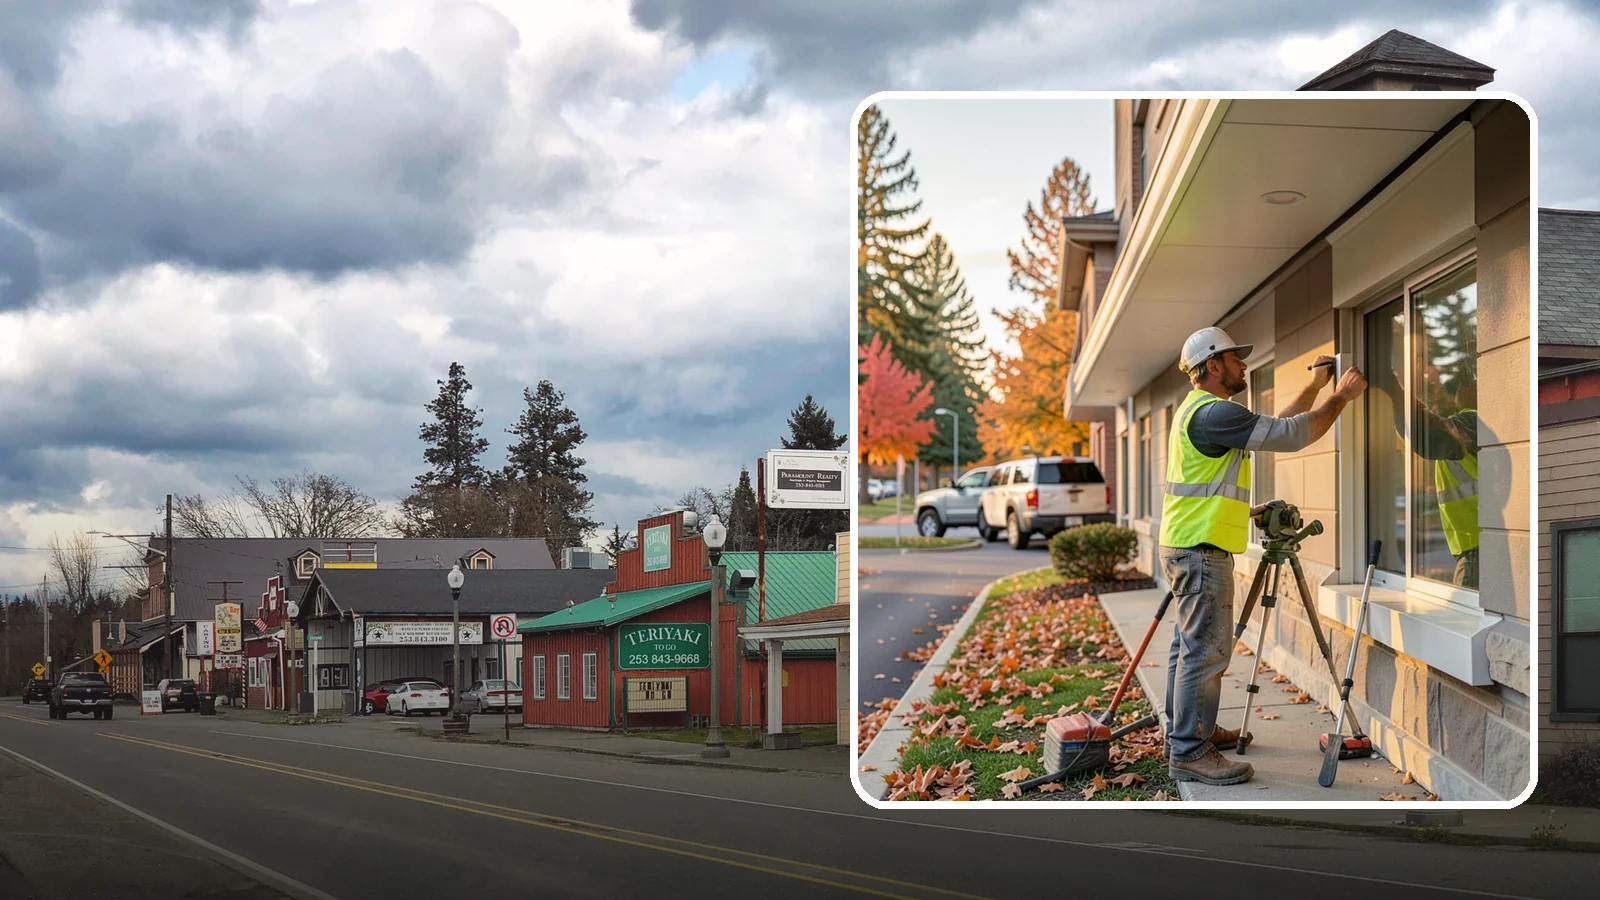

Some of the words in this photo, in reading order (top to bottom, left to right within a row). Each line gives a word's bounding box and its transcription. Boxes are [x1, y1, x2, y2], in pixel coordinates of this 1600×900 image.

[781, 471, 815, 479] PARAMOUNT
[646, 530, 669, 549] TERIYAKI
[624, 627, 702, 646] TERIYAKI
[629, 654, 648, 665] 253
[651, 653, 700, 664] 843-9668
[639, 681, 673, 691] TERIYAKI
